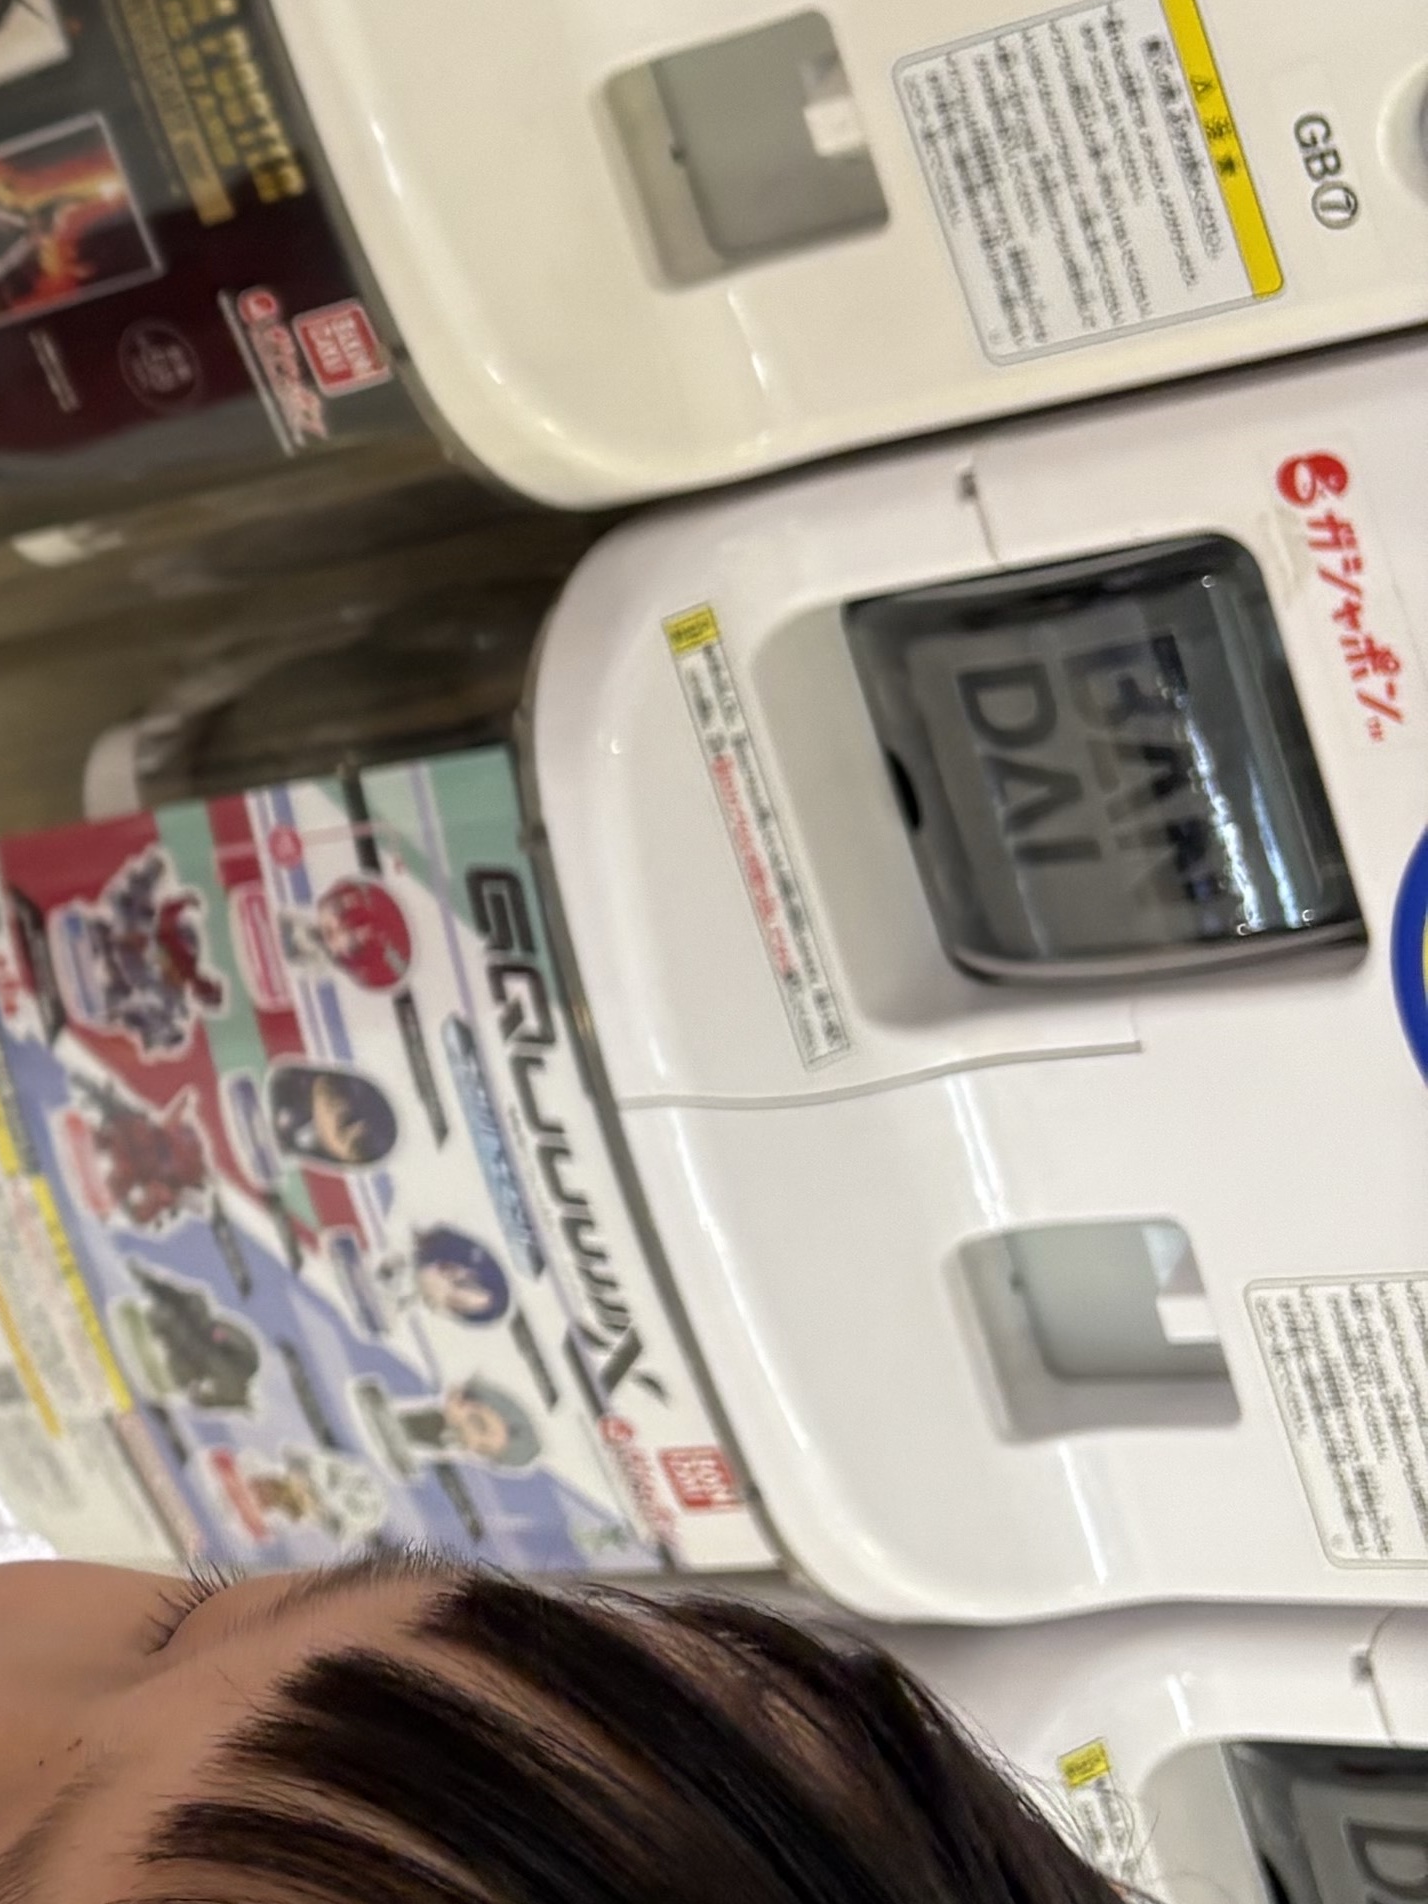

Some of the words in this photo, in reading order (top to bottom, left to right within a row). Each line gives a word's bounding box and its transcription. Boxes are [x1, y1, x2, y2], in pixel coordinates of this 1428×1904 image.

[1308, 508, 1406, 728] ガシャポン
[953, 657, 1103, 874] DAI
